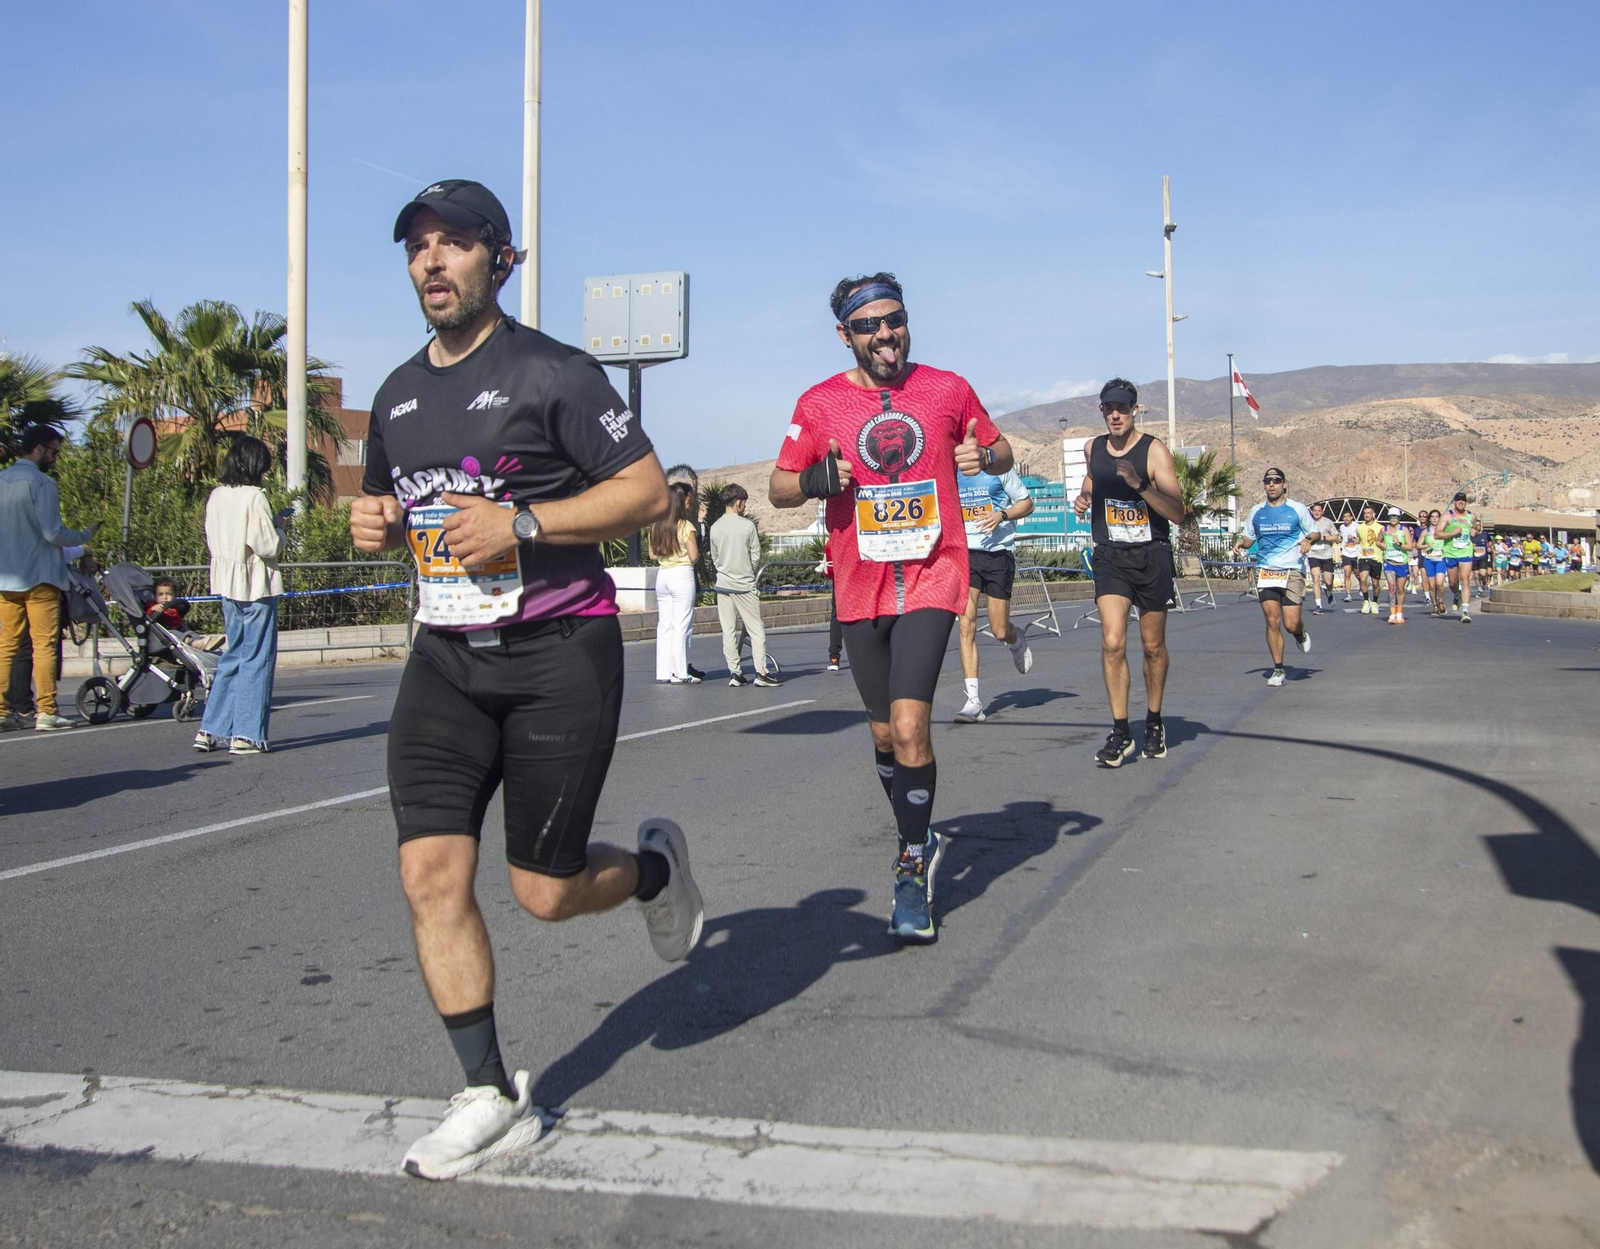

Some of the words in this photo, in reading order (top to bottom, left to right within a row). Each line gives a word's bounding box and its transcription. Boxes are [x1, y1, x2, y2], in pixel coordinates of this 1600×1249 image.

[390, 398, 418, 420] HOKA
[598, 408, 616, 427] FLY
[874, 412, 904, 425] CARADURA
[611, 424, 629, 443] FLY
[858, 419, 876, 446] CARADURA
[901, 415, 924, 438] CARADURA
[858, 445, 880, 470] CARADURA
[905, 437, 924, 466] CARADURA
[973, 489, 990, 498] 2025
[873, 497, 923, 523] 826
[1111, 507, 1145, 522] 1308
